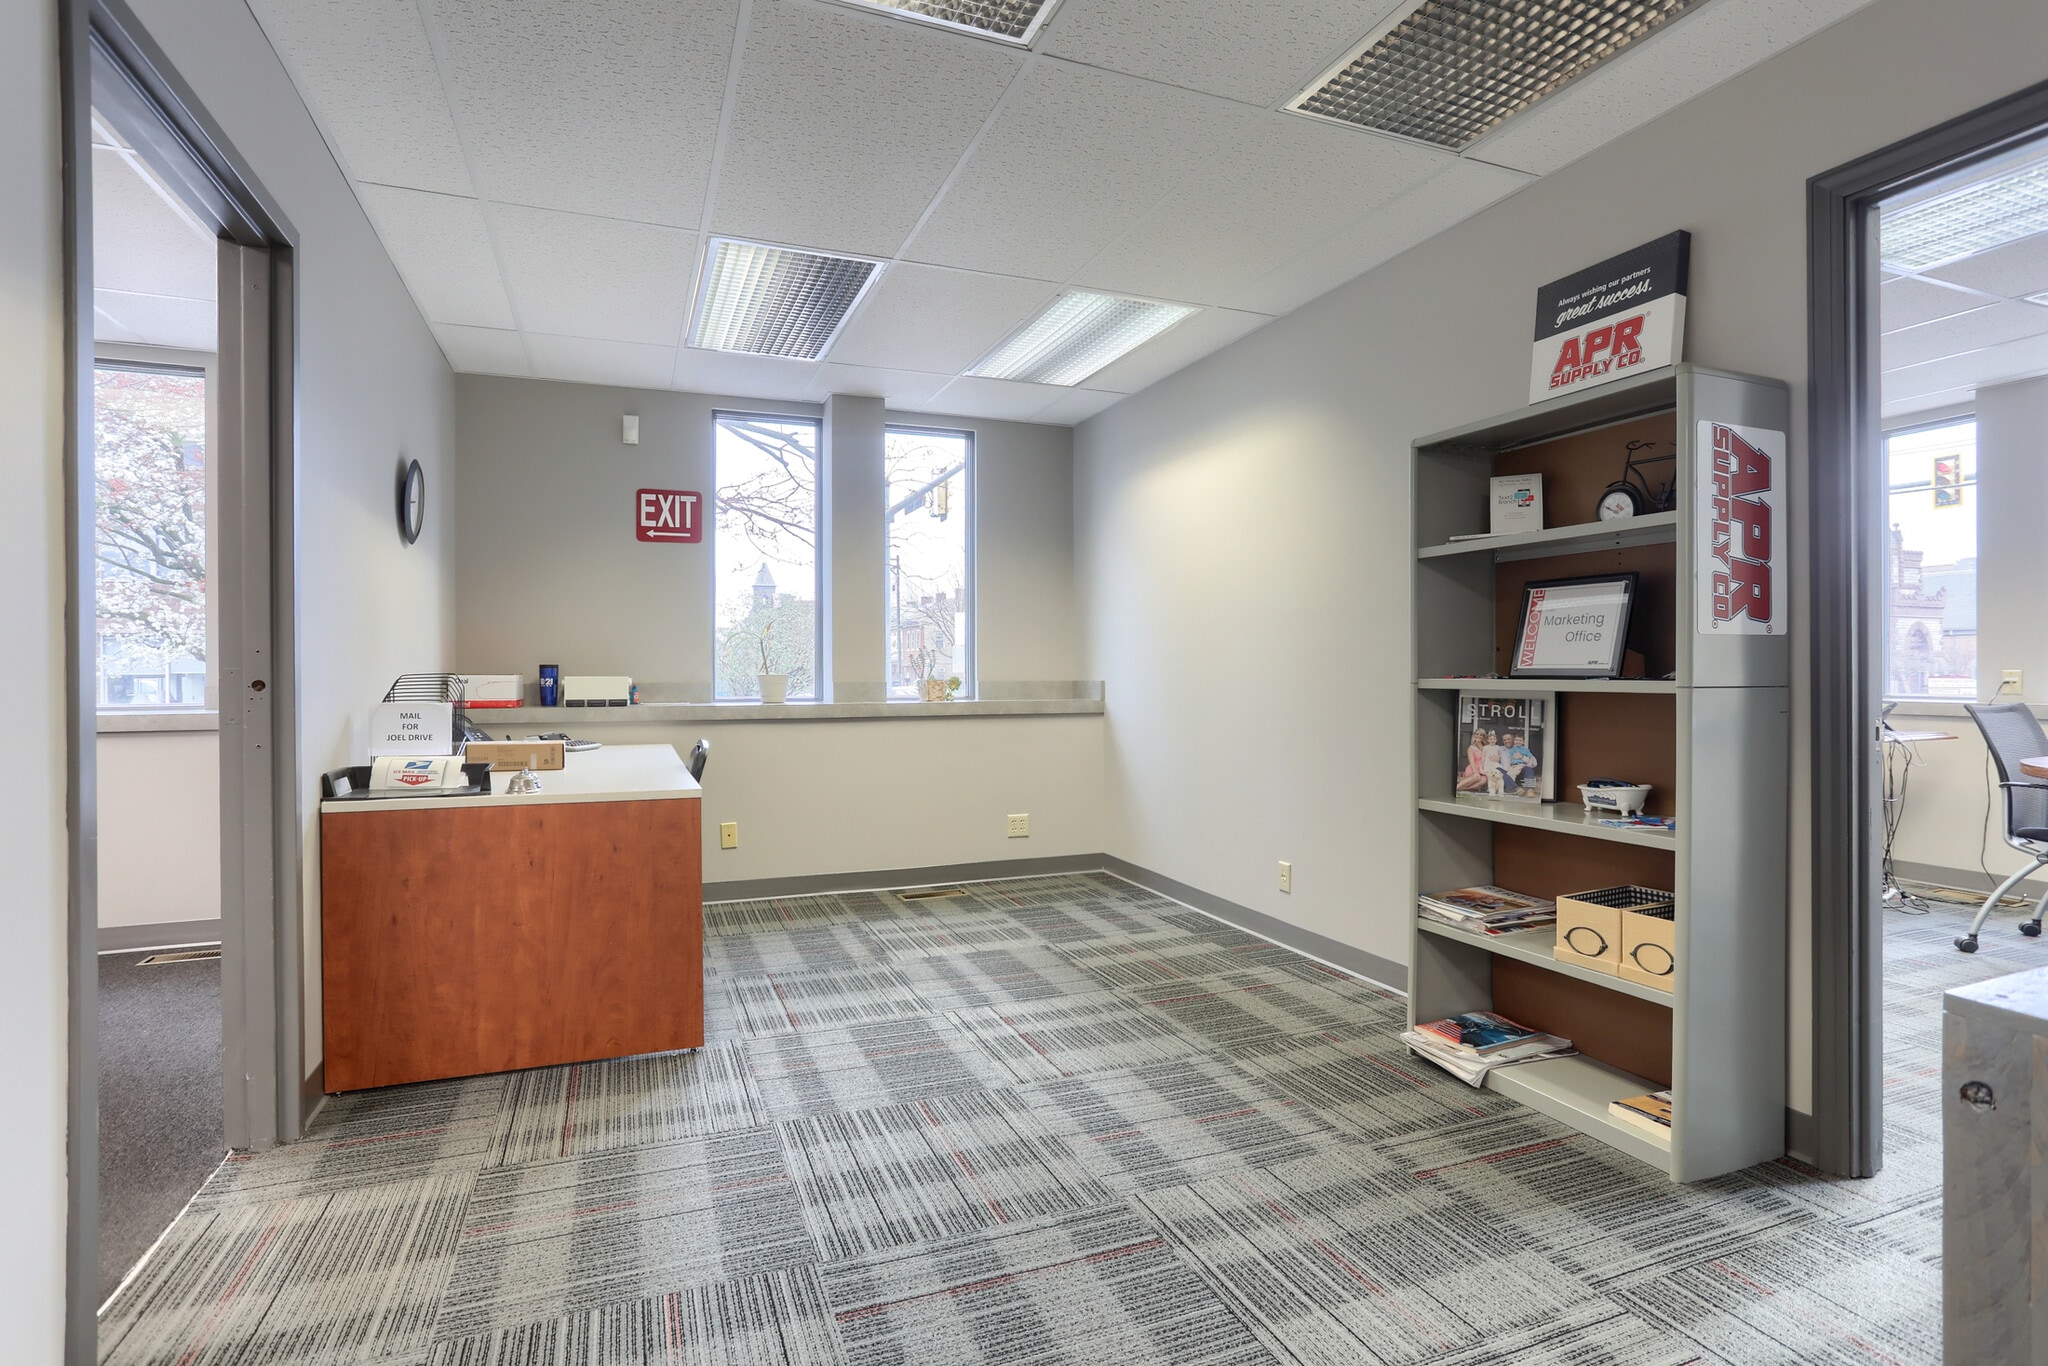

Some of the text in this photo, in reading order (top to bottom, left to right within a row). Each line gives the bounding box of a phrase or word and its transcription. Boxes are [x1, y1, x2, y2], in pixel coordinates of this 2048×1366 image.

[1554, 278, 1652, 328] great success.
[1558, 266, 1651, 307] Always wishing our partners
[1553, 313, 1645, 375] APR
[1549, 357, 1614, 390] SUPPLY
[641, 493, 697, 528] EXIT
[1712, 423, 1731, 570] SUPPLY
[1730, 428, 1772, 623] APR
[1521, 589, 1545, 667] WELCOME
[1544, 613, 1605, 627] Marketing
[1565, 631, 1602, 642] Office
[1467, 704, 1540, 719] STROLL
[408, 733, 433, 741] DRIVE
